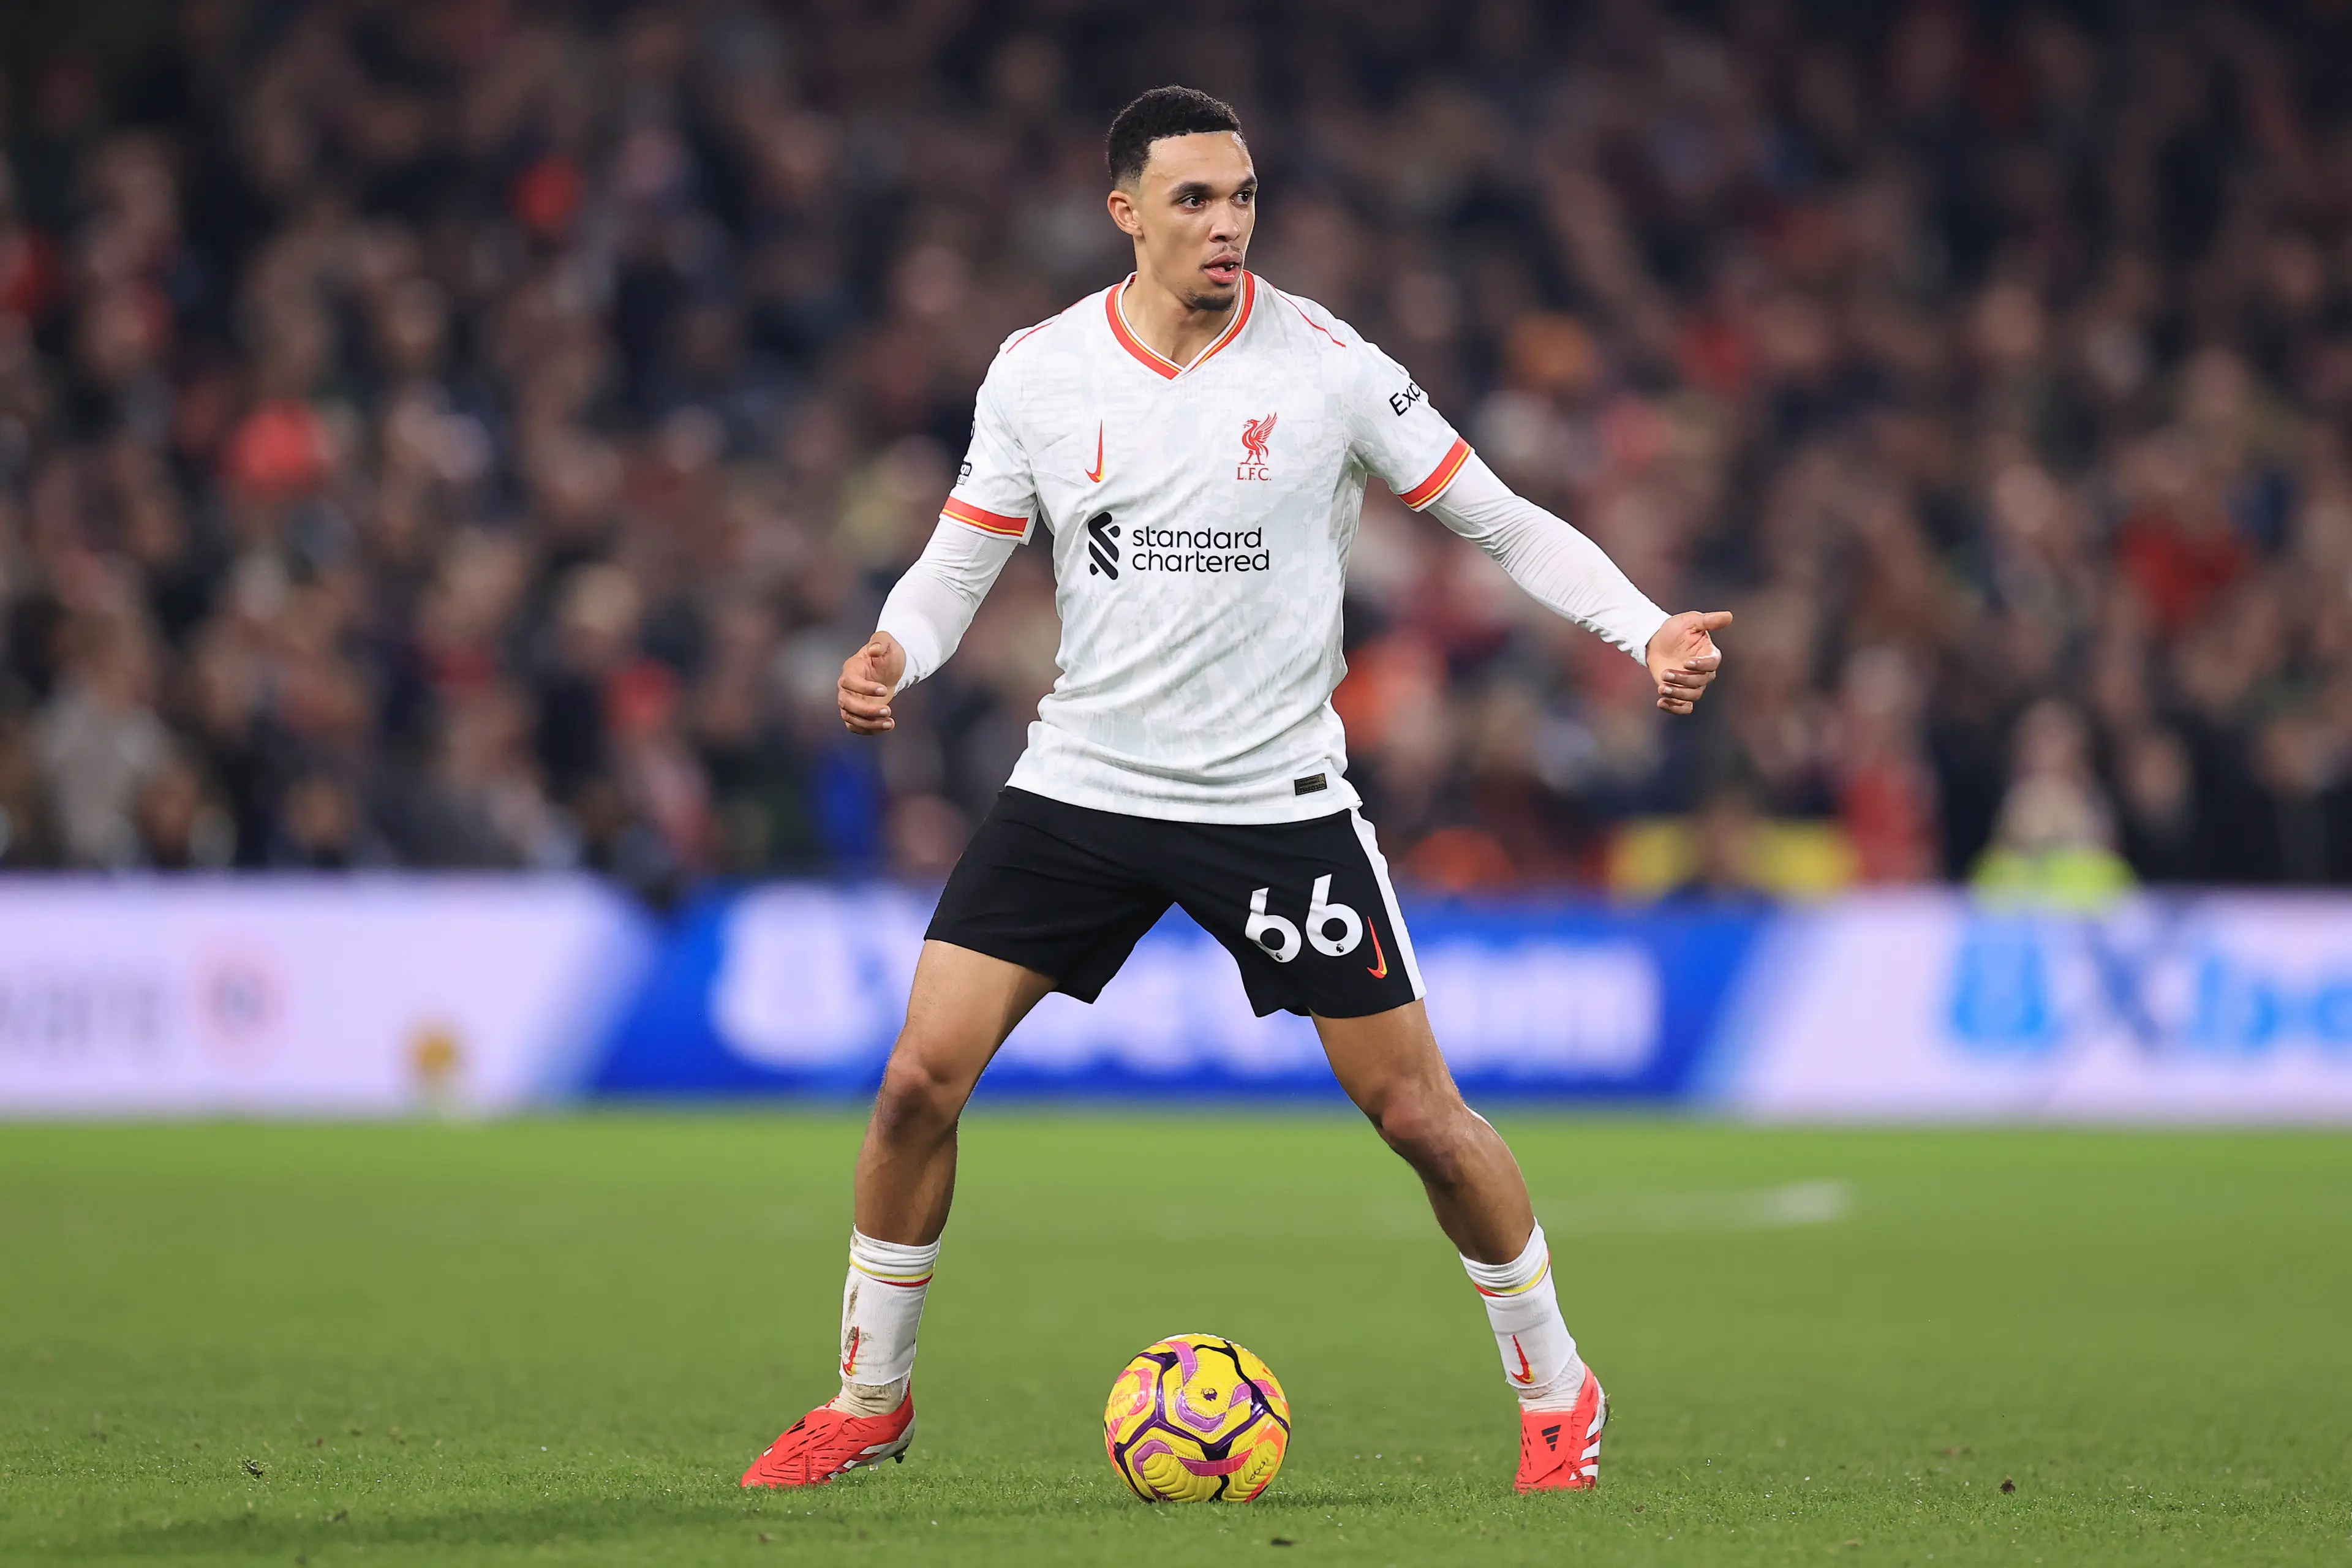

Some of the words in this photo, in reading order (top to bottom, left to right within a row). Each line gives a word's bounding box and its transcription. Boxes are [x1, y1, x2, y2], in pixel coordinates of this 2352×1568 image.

[1237, 467, 1272, 481] L.F.C.
[1133, 526, 1262, 549] standard
[1132, 549, 1270, 573] chartered
[1245, 873, 1363, 963] 66
